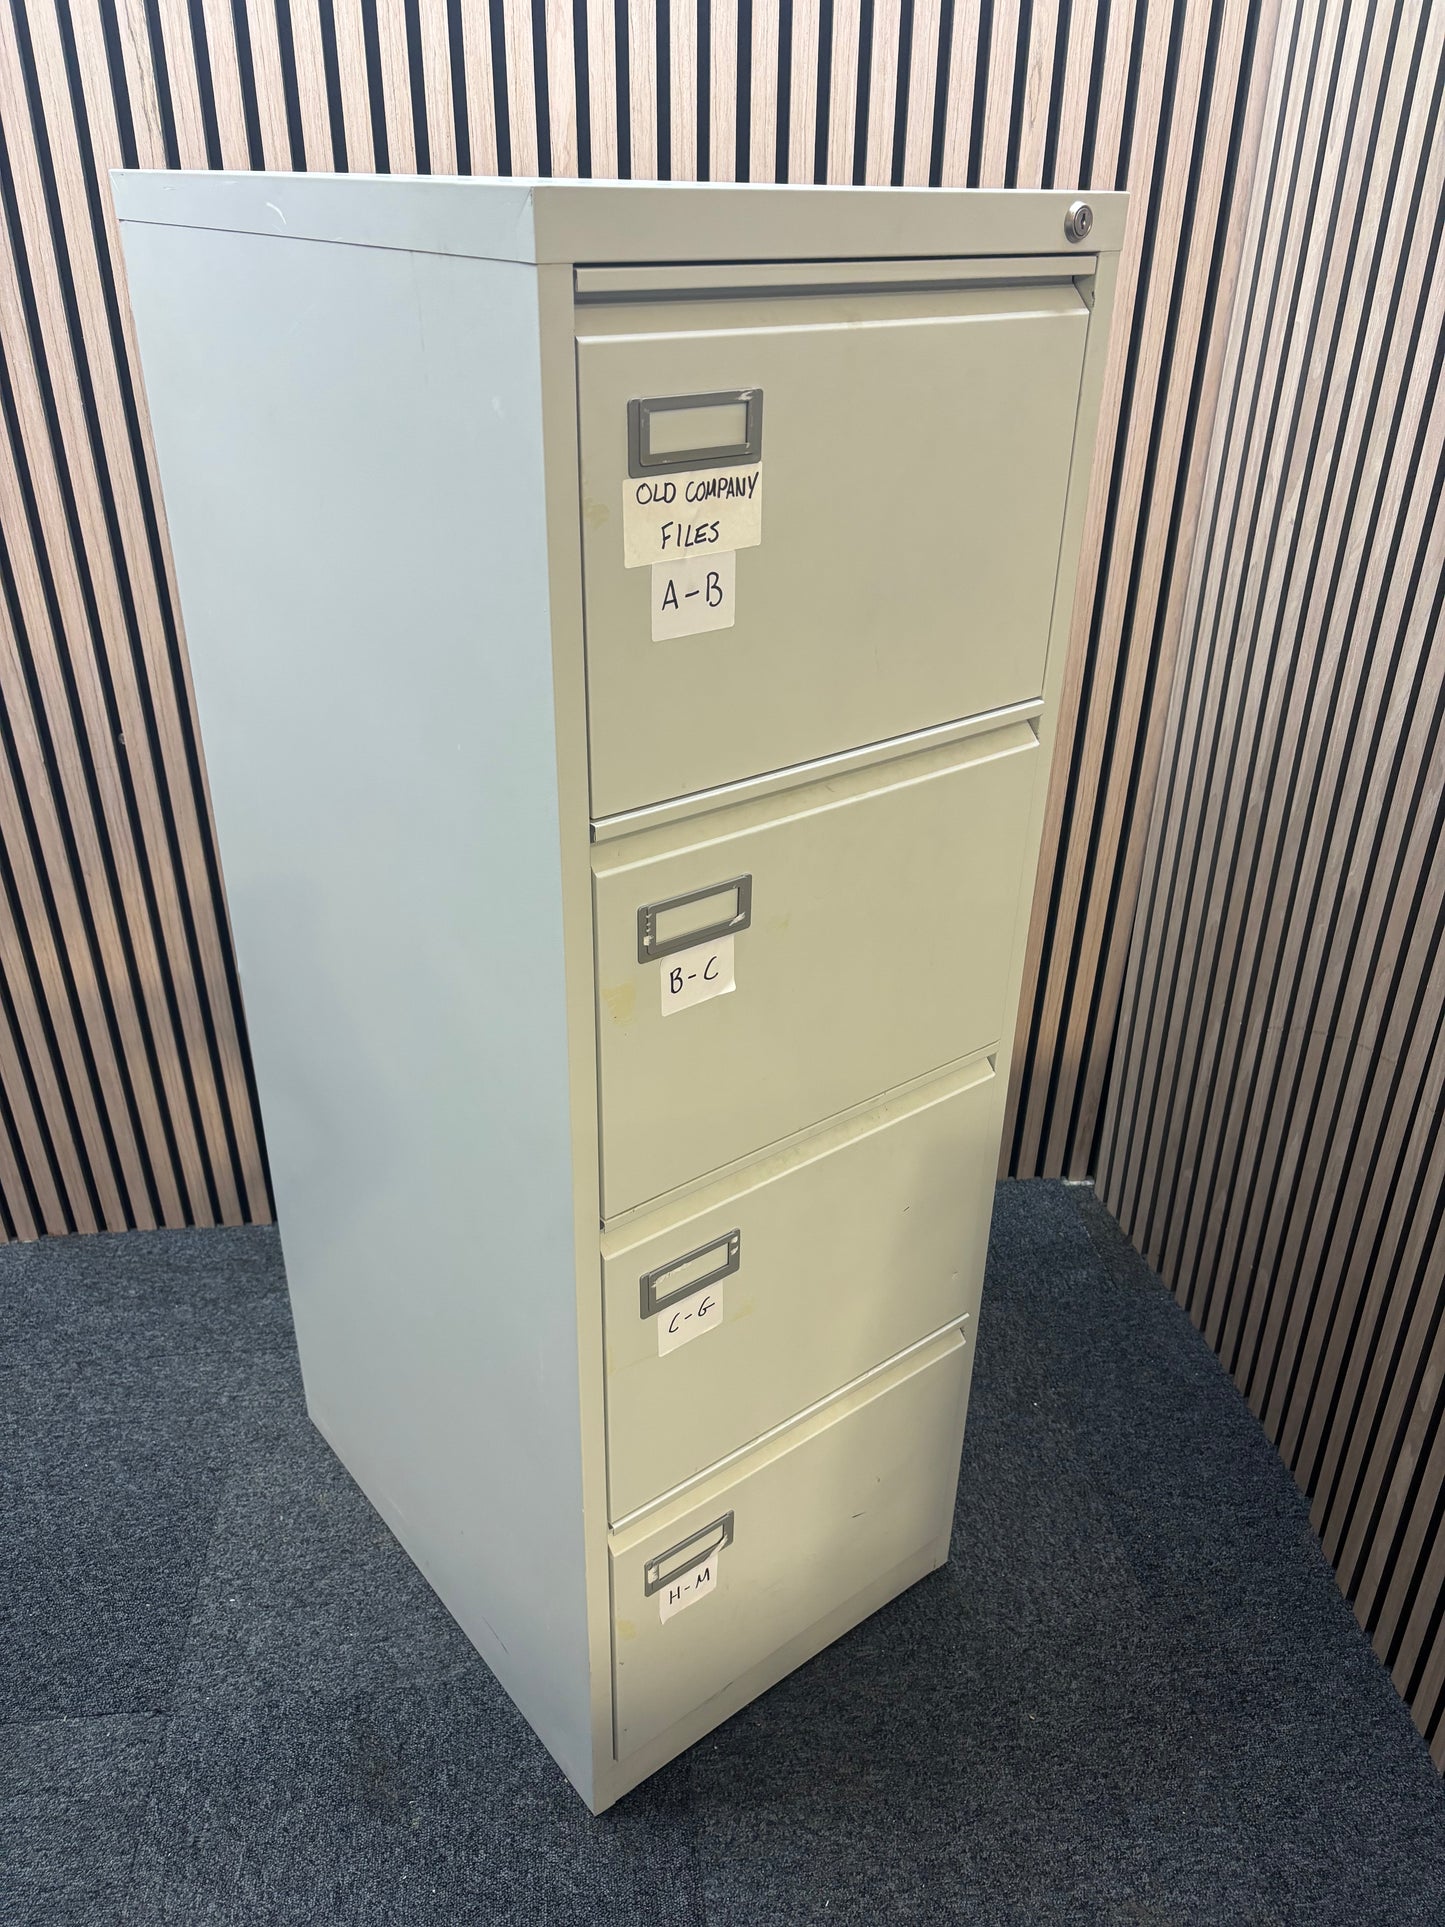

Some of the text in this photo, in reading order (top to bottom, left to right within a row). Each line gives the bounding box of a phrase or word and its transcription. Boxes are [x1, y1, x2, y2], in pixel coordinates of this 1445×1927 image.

[636, 471, 760, 505] OLD COMPANY
[661, 520, 720, 549] FILES
